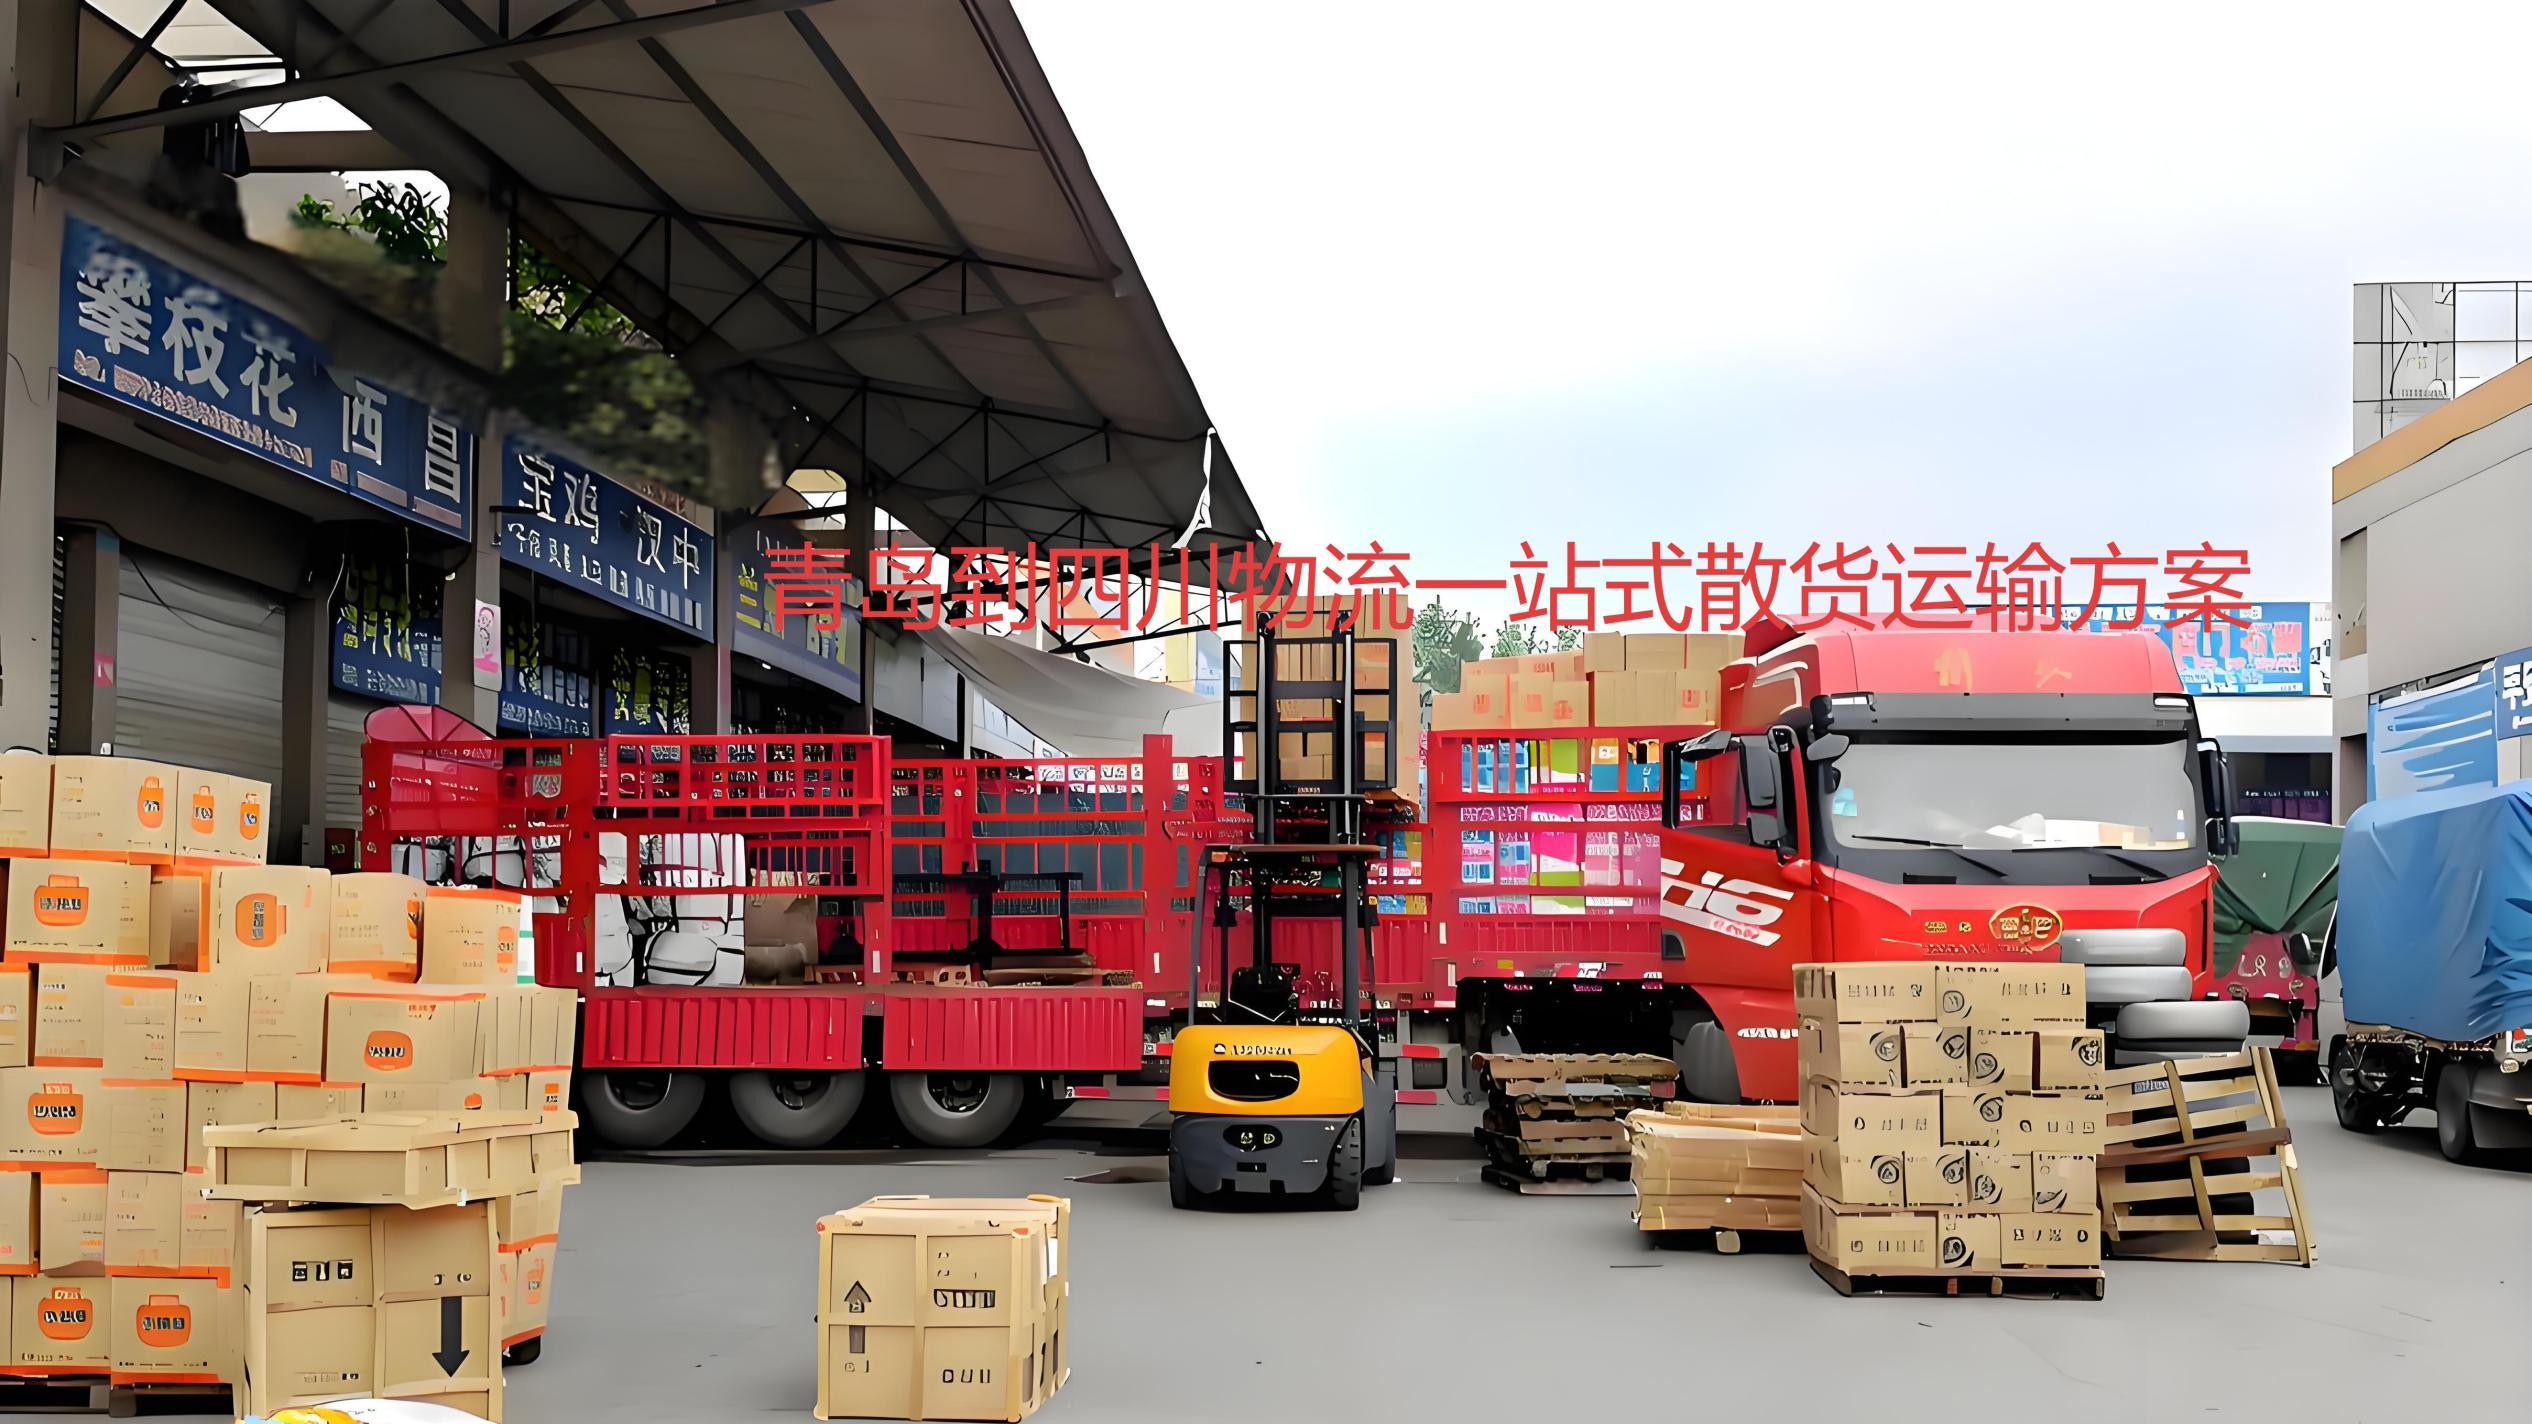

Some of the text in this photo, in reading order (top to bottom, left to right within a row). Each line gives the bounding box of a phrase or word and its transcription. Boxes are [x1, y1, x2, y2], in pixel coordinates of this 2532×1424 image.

[77, 256, 298, 428] 攀枝花
[342, 377, 462, 503] 西昌
[635, 504, 701, 590] 汉中
